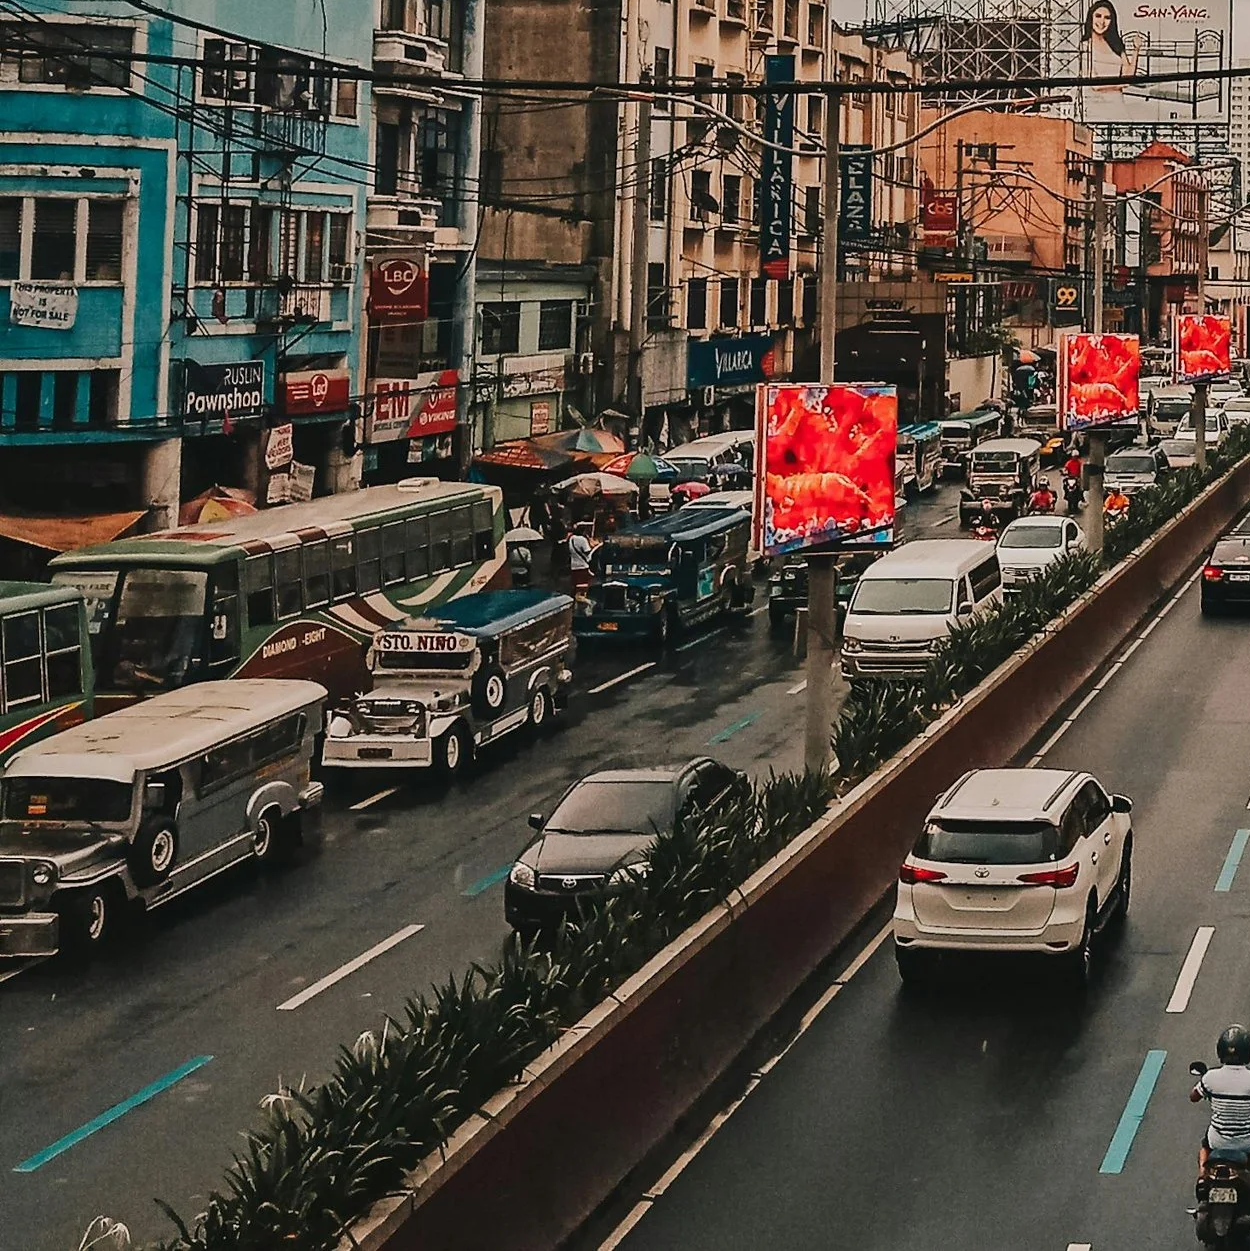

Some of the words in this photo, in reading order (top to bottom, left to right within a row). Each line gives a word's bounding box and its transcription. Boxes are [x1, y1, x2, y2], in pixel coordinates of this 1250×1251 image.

[384, 270, 413, 283] LBC
[39, 298, 47, 306] IS
[1057, 287, 1077, 305] 99
[31, 310, 47, 319] FOR
[49, 311, 69, 322] SALE
[224, 366, 262, 386] RUSLIN
[186, 388, 261, 414] Pawnshop
[428, 409, 456, 423] VIKING
[262, 636, 297, 659] DIAMOND
[382, 635, 413, 651] STO.
